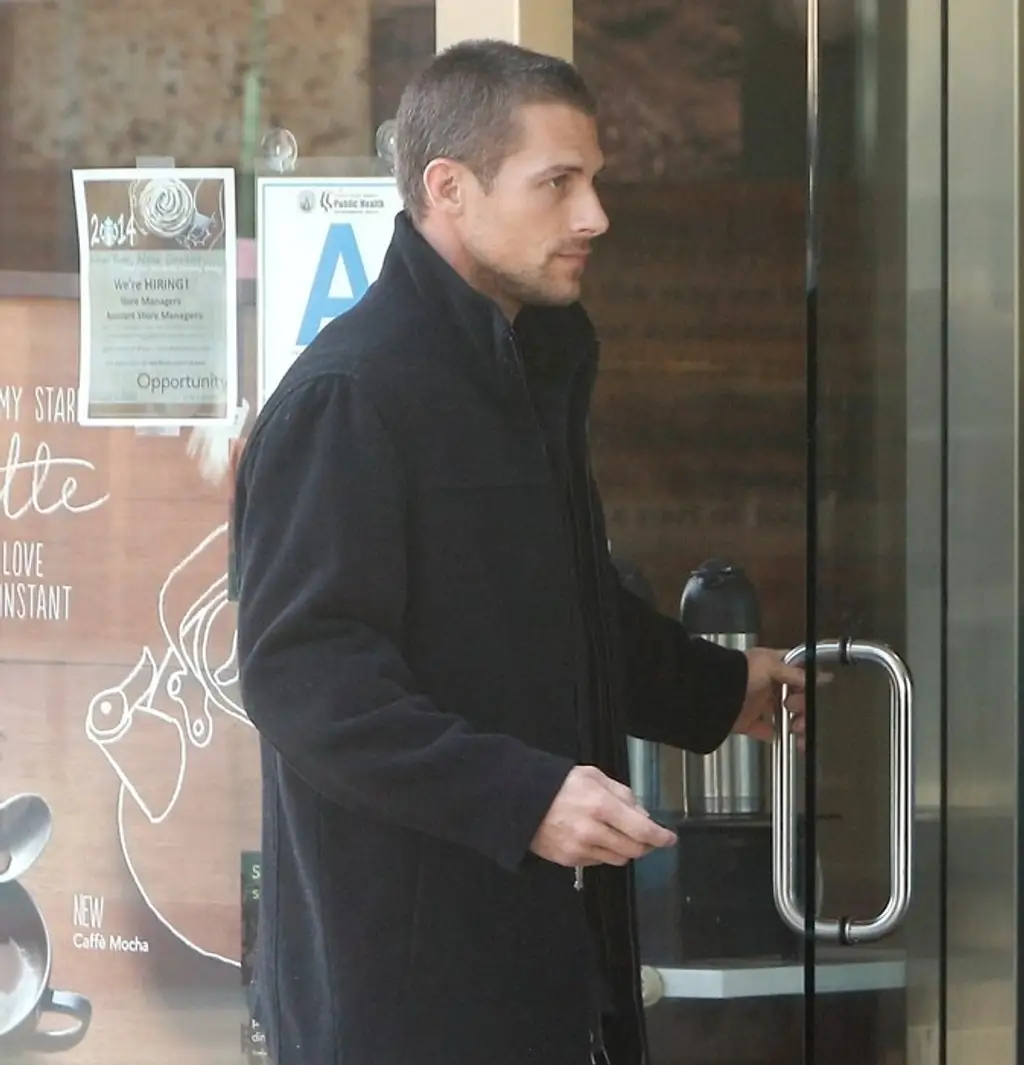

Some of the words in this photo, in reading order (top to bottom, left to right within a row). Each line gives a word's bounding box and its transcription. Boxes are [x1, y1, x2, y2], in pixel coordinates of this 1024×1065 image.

[114, 278, 142, 291] We're
[296, 223, 369, 346] A
[3, 540, 44, 578] LOVE
[73, 893, 104, 928] NEW
[109, 935, 149, 952] Mocha
